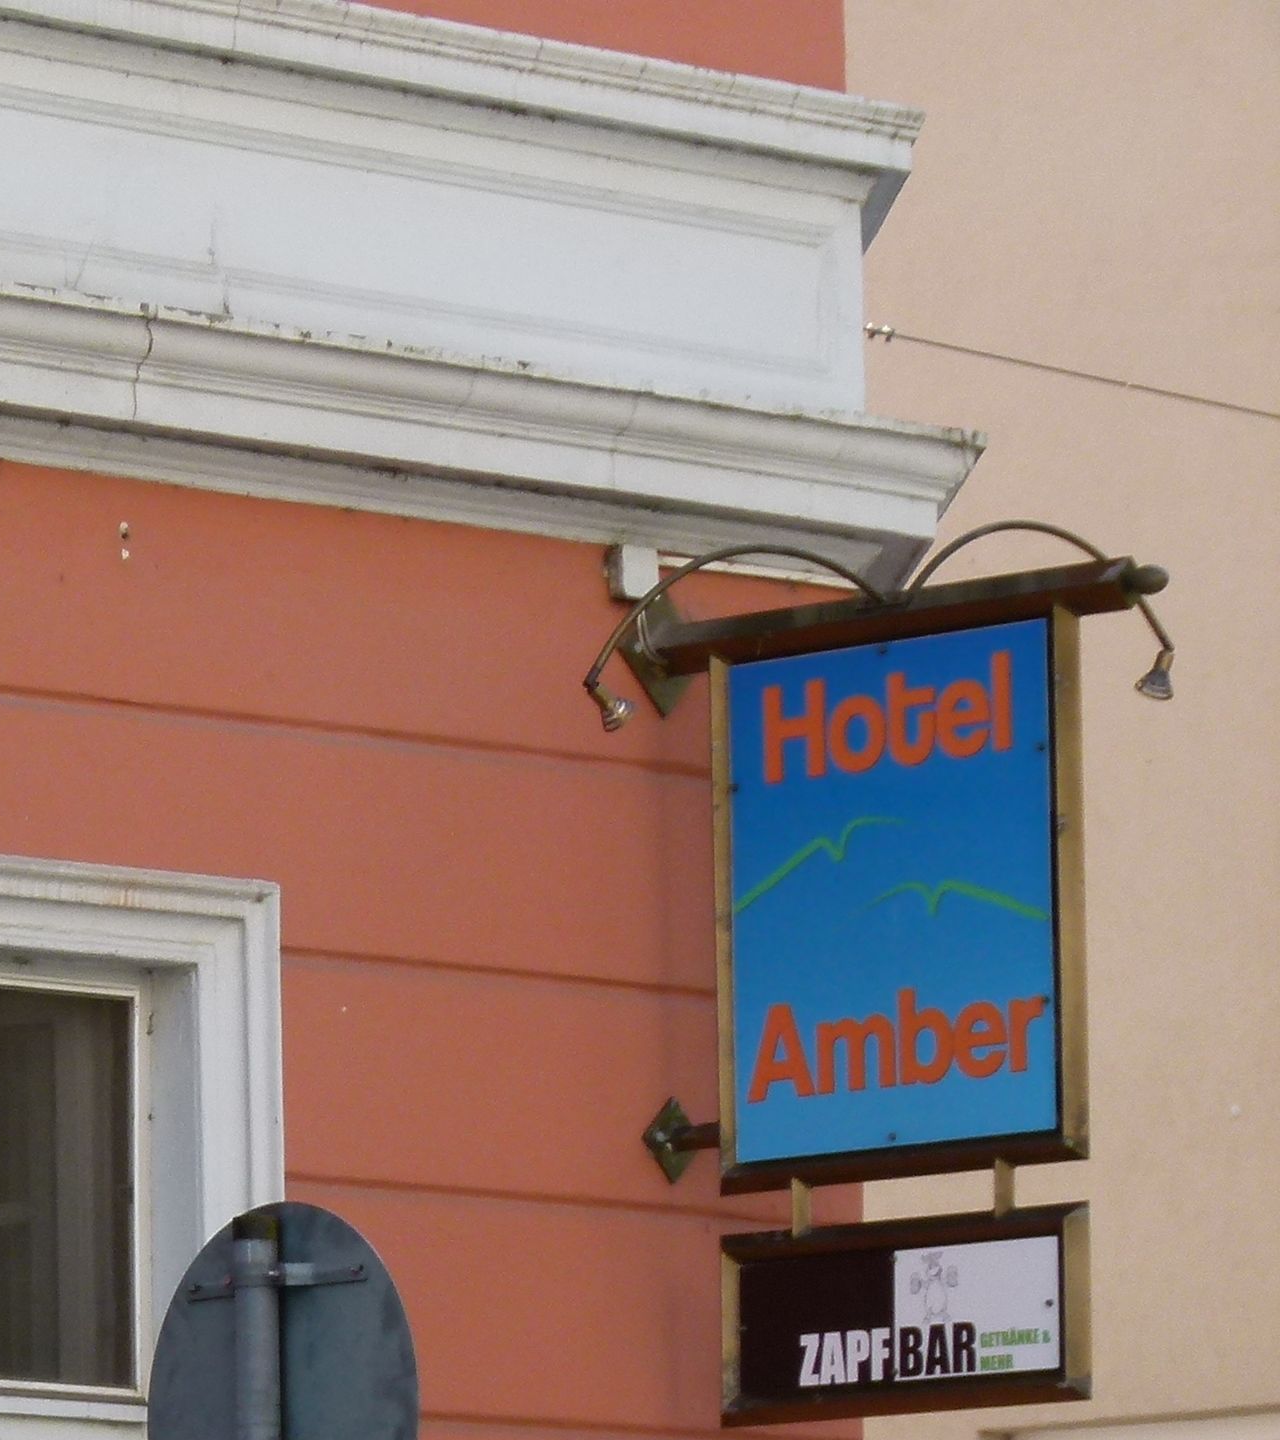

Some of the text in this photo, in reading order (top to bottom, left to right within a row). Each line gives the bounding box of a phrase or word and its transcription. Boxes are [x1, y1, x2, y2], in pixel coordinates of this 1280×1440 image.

[761, 650, 1013, 785] Hotel
[747, 987, 1046, 1104] Amber
[799, 1321, 977, 1387] ZAPF BAR
